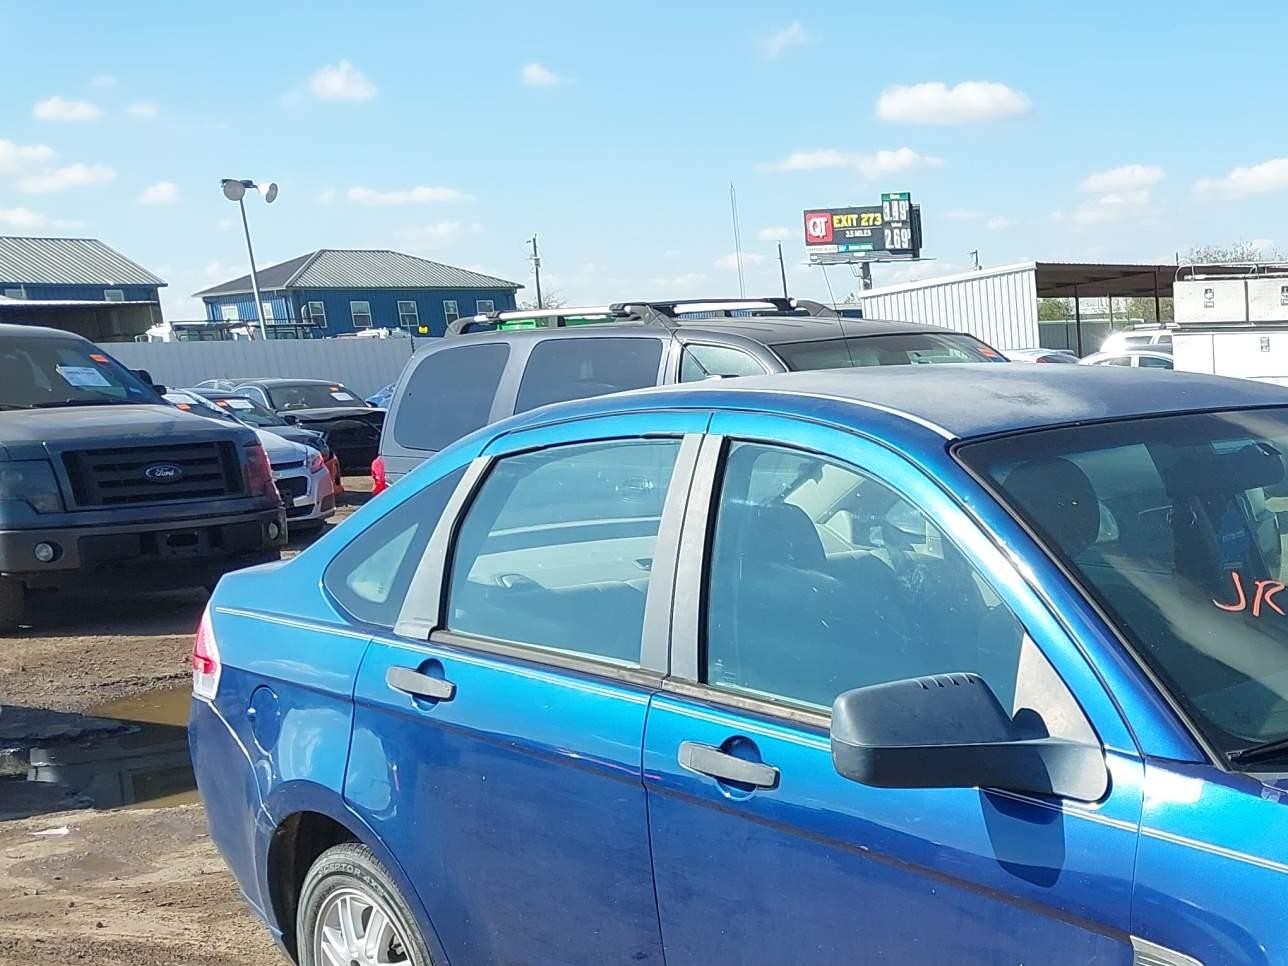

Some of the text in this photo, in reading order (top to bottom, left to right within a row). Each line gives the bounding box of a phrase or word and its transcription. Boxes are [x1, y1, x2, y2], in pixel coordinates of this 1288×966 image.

[808, 217, 828, 239] QT
[833, 212, 882, 228] EXIT 273
[154, 468, 175, 477] Ford
[1212, 571, 1286, 617] JR
